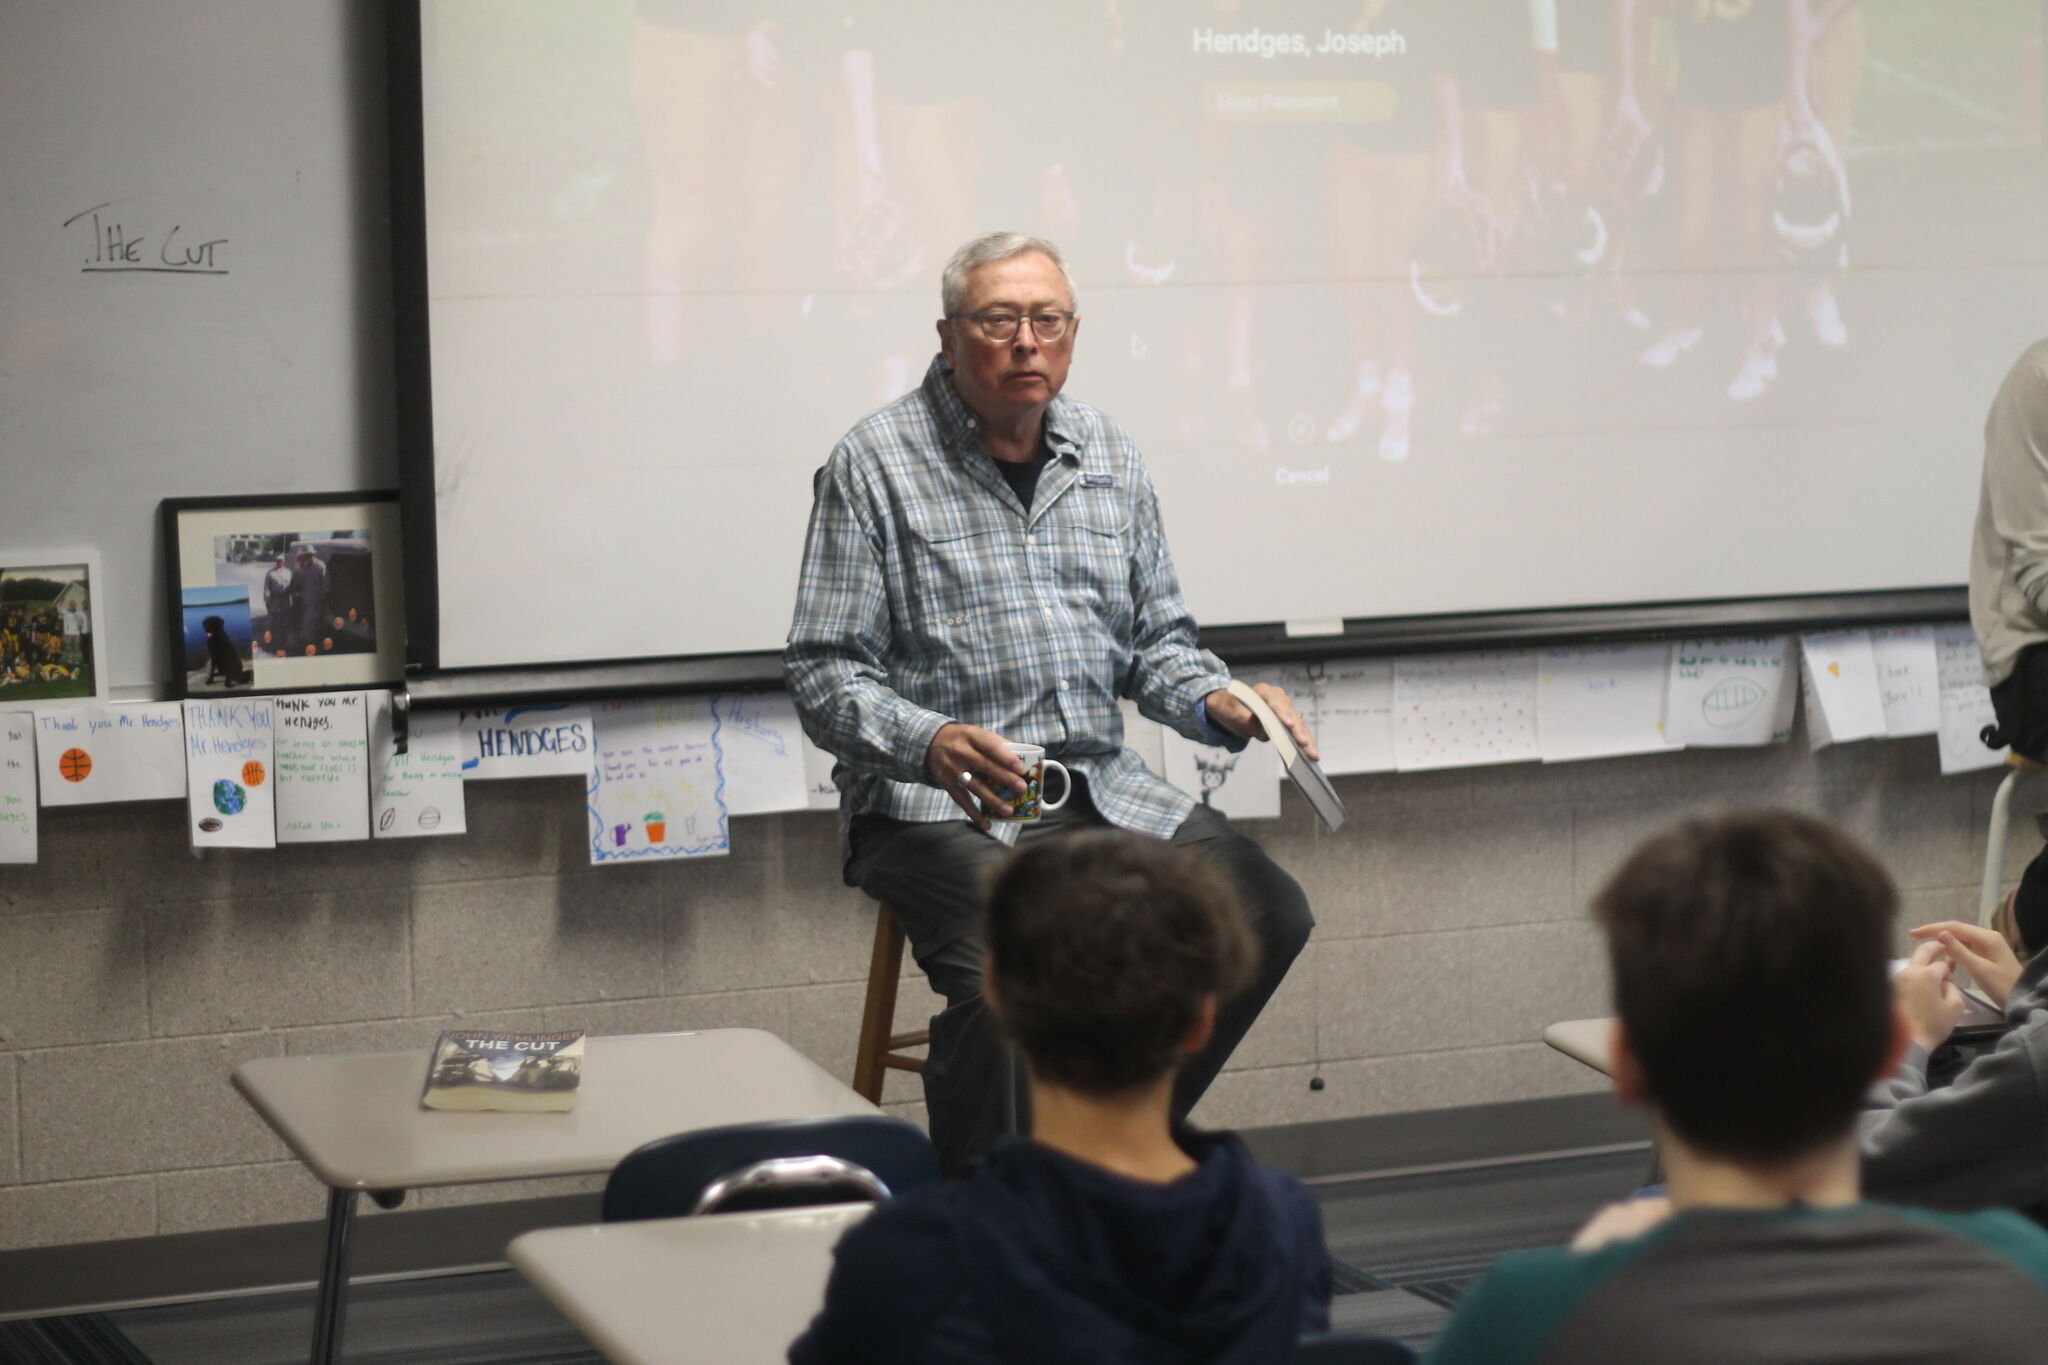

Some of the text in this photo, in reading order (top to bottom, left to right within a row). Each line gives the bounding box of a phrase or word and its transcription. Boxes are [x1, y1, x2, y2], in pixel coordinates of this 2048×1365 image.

[1192, 27, 1407, 59] Hendges, Joseph
[40, 716, 78, 732] Thank
[478, 723, 587, 758] HENDGES
[450, 1031, 488, 1040] JOHN
[465, 1039, 560, 1051] THE CUT
